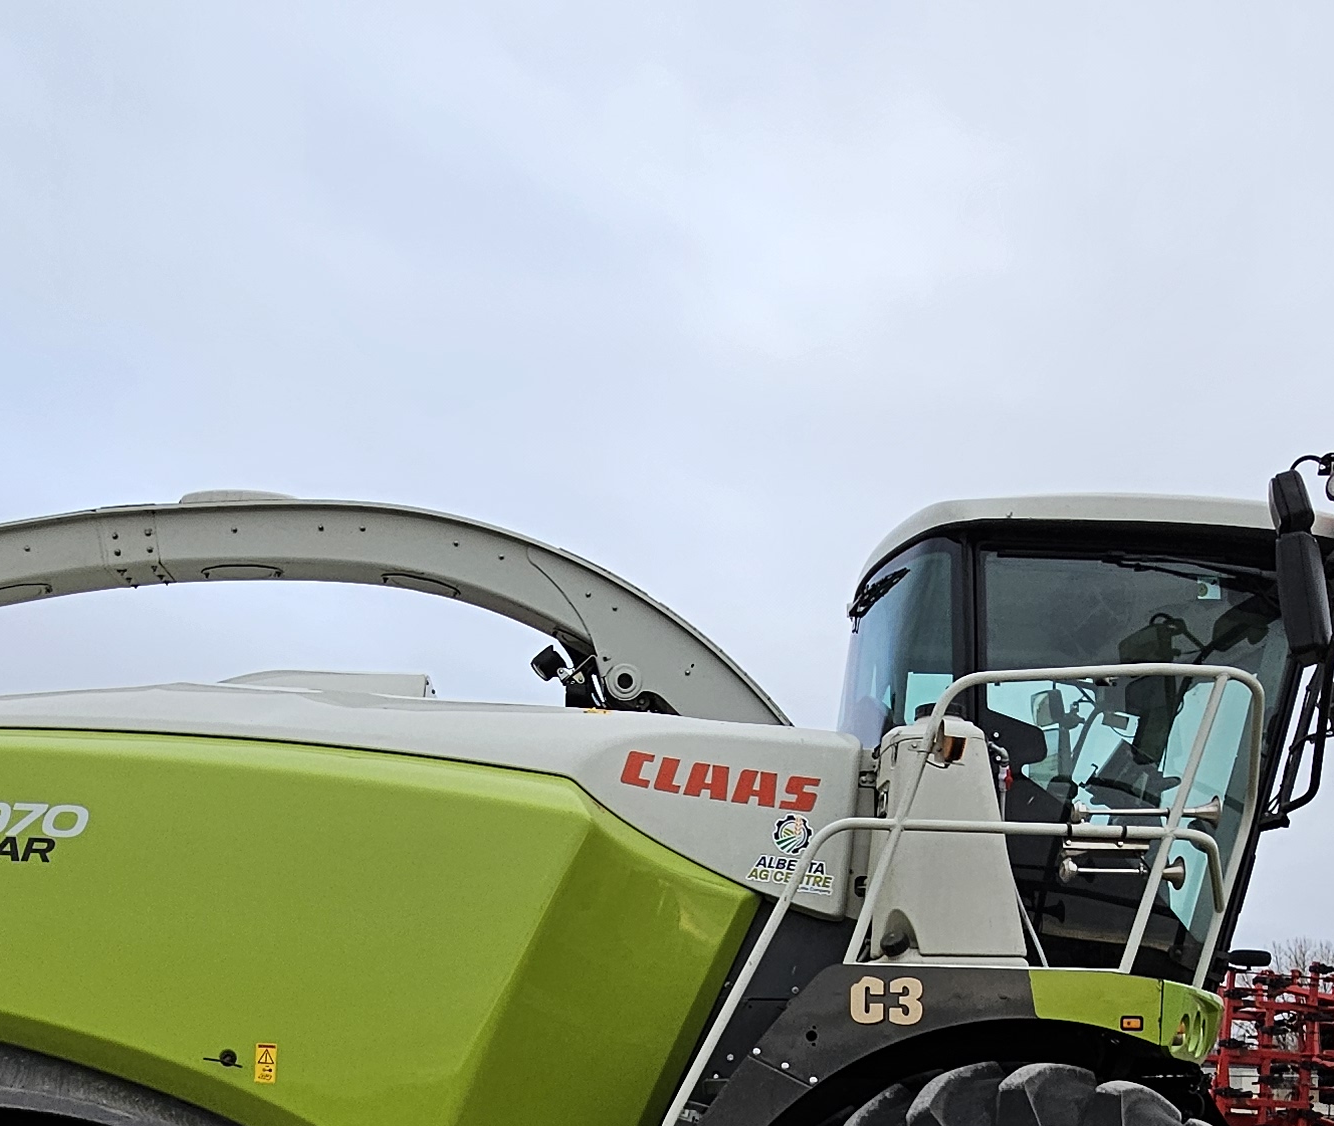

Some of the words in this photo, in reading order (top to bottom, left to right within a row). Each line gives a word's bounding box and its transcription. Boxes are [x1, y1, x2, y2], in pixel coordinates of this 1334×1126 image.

[620, 750, 821, 812] CLAAS
[747, 867, 770, 881] AG
[773, 870, 833, 889] CETRE
[755, 856, 825, 875] ALBETA
[850, 976, 923, 1025] C3
